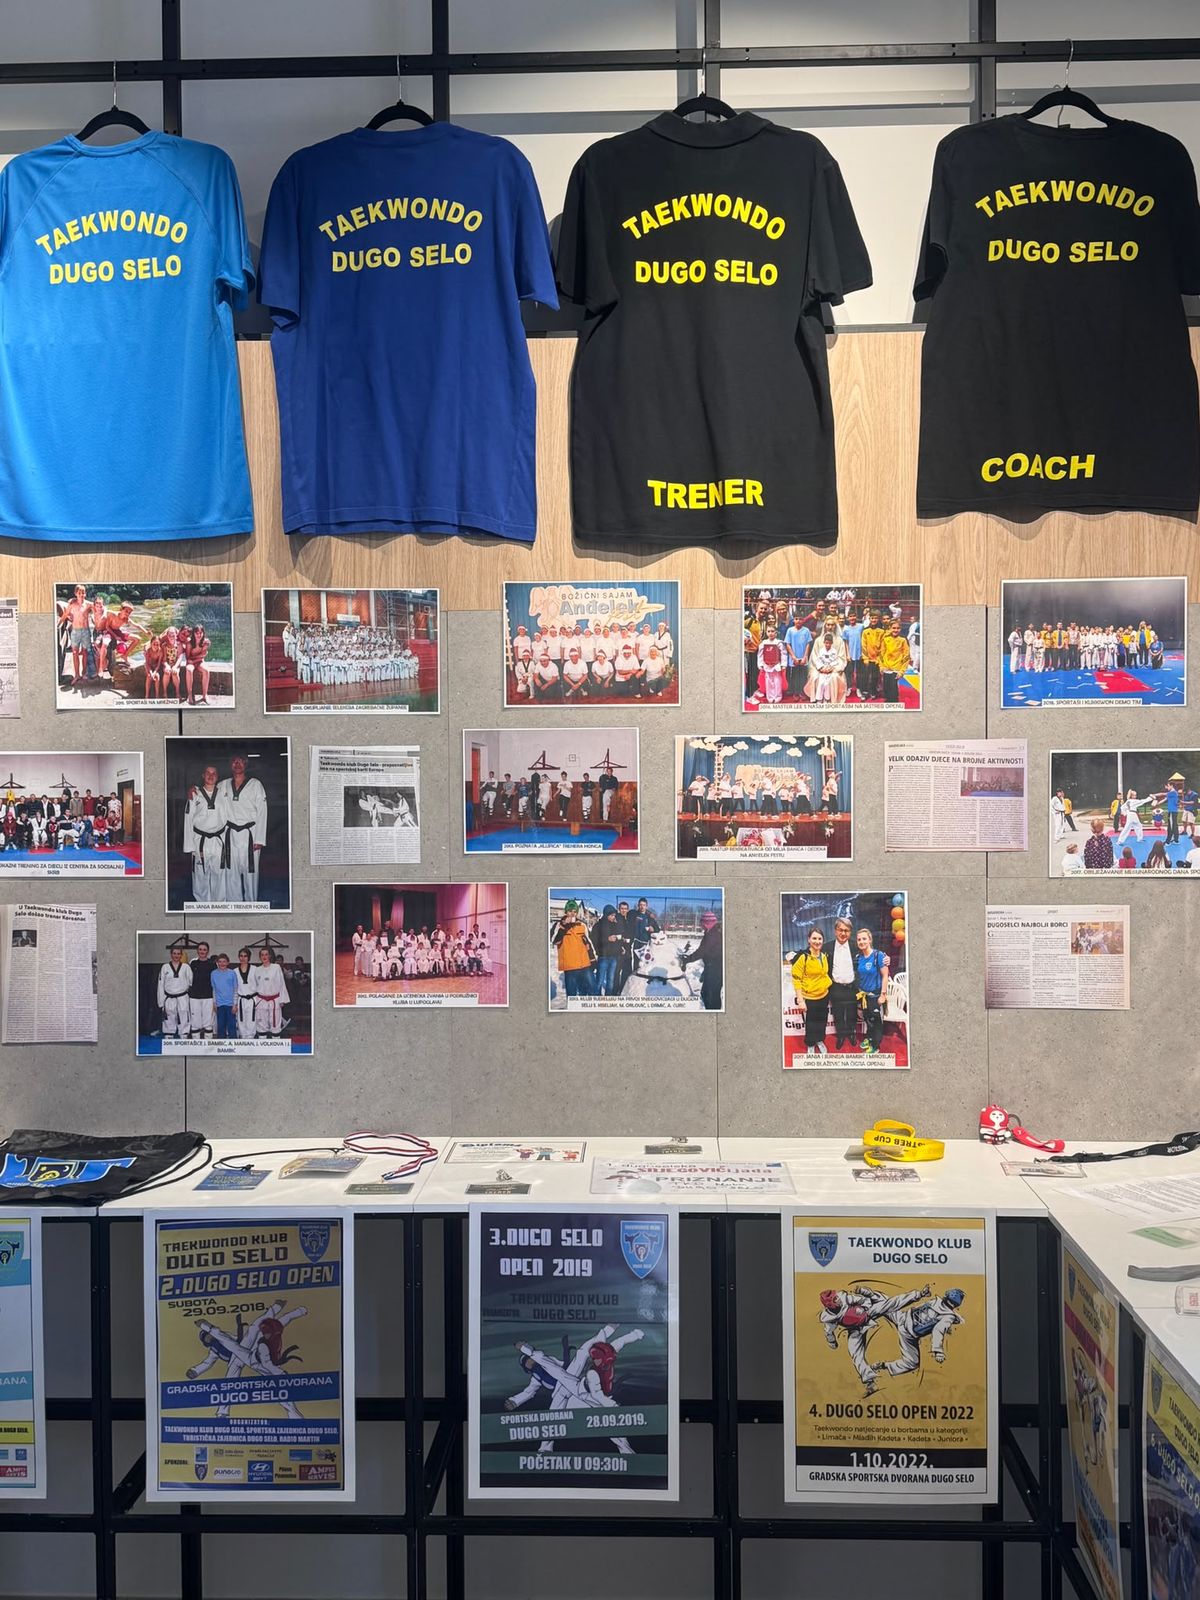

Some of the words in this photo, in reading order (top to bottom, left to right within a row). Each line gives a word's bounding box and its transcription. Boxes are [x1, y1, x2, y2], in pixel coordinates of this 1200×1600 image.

[975, 180, 1155, 220] TAEKWONDO
[319, 197, 483, 243] TAEKWONDO
[622, 193, 786, 242] TAEKWONDO
[36, 210, 188, 256] TAEKWONDO
[331, 247, 401, 273] DUGO
[409, 243, 472, 268] SELO
[988, 239, 1060, 263] DUGO
[1069, 241, 1140, 263] SELO
[49, 261, 114, 285] DUGO
[122, 255, 182, 280] SELO
[635, 260, 707, 285] DUGO
[714, 260, 778, 286] SELO
[981, 453, 1096, 483] COACH
[647, 479, 764, 510] TRENER
[602, 592, 633, 600] SAJAM
[24, 905, 55, 914] Taekwondo
[874, 1135, 891, 1144] CUP
[162, 1236, 247, 1253] TAEKWONDO
[251, 1232, 288, 1245] KLUB
[490, 1228, 551, 1246] 3.DUGO
[561, 1228, 602, 1246] SELO
[848, 1237, 933, 1248] TAEKWONDO
[938, 1238, 972, 1249] KLUB
[166, 1251, 224, 1269] DUGO
[232, 1246, 288, 1264] SELO
[873, 1253, 911, 1264] DUGO
[915, 1254, 948, 1264] SELO
[500, 1258, 543, 1276] OPEN
[553, 1258, 592, 1276] 2019
[161, 1274, 230, 1296] 2.DUGO
[236, 1270, 280, 1289] SELO
[287, 1266, 334, 1284] OPEN
[168, 1298, 216, 1308] SUBOTA
[510, 1293, 585, 1305] TAEKWONDO
[588, 1294, 619, 1306] KLUB
[183, 1303, 269, 1316] 29.09.2018.
[533, 1308, 564, 1320] DUGO
[567, 1309, 597, 1320] SELO
[167, 1384, 218, 1394] GRADSKA
[220, 1380, 276, 1391] SPORTSKA
[279, 1376, 332, 1387] DVORANA
[210, 1392, 248, 1404] DUGO
[252, 1390, 288, 1401] SELO
[500, 1414, 539, 1424] SPORTSKA
[540, 1411, 574, 1421] DVORANA
[586, 1413, 647, 1428] 28.09.2019.
[809, 1404, 822, 1417] 4.
[826, 1404, 863, 1418] DUGO
[867, 1405, 898, 1419] SELO
[902, 1406, 937, 1420] OPEN
[941, 1406, 974, 1420] 2022
[1169, 1397, 1197, 1442] TAEKWONDO
[247, 1434, 263, 1442] DUGO
[510, 1427, 539, 1440] DUGO
[542, 1424, 567, 1438] SELO
[854, 1426, 890, 1434] natjecanje
[1175, 1425, 1188, 1451] DUGO
[1187, 1442, 1199, 1467] SELO
[519, 1453, 571, 1470] POČETAK
[574, 1457, 581, 1470] U
[584, 1457, 627, 1471] 09:30h
[850, 1452, 934, 1468] 1.10.2022.
[809, 1472, 846, 1481] GRADSKA
[848, 1472, 889, 1482] SPORTSKA
[890, 1473, 929, 1483] DVORANA
[931, 1474, 953, 1483] DUGO
[955, 1474, 974, 1483] SELO
[1158, 1443, 1176, 1475] DUGO
[1176, 1470, 1194, 1501] SELO
